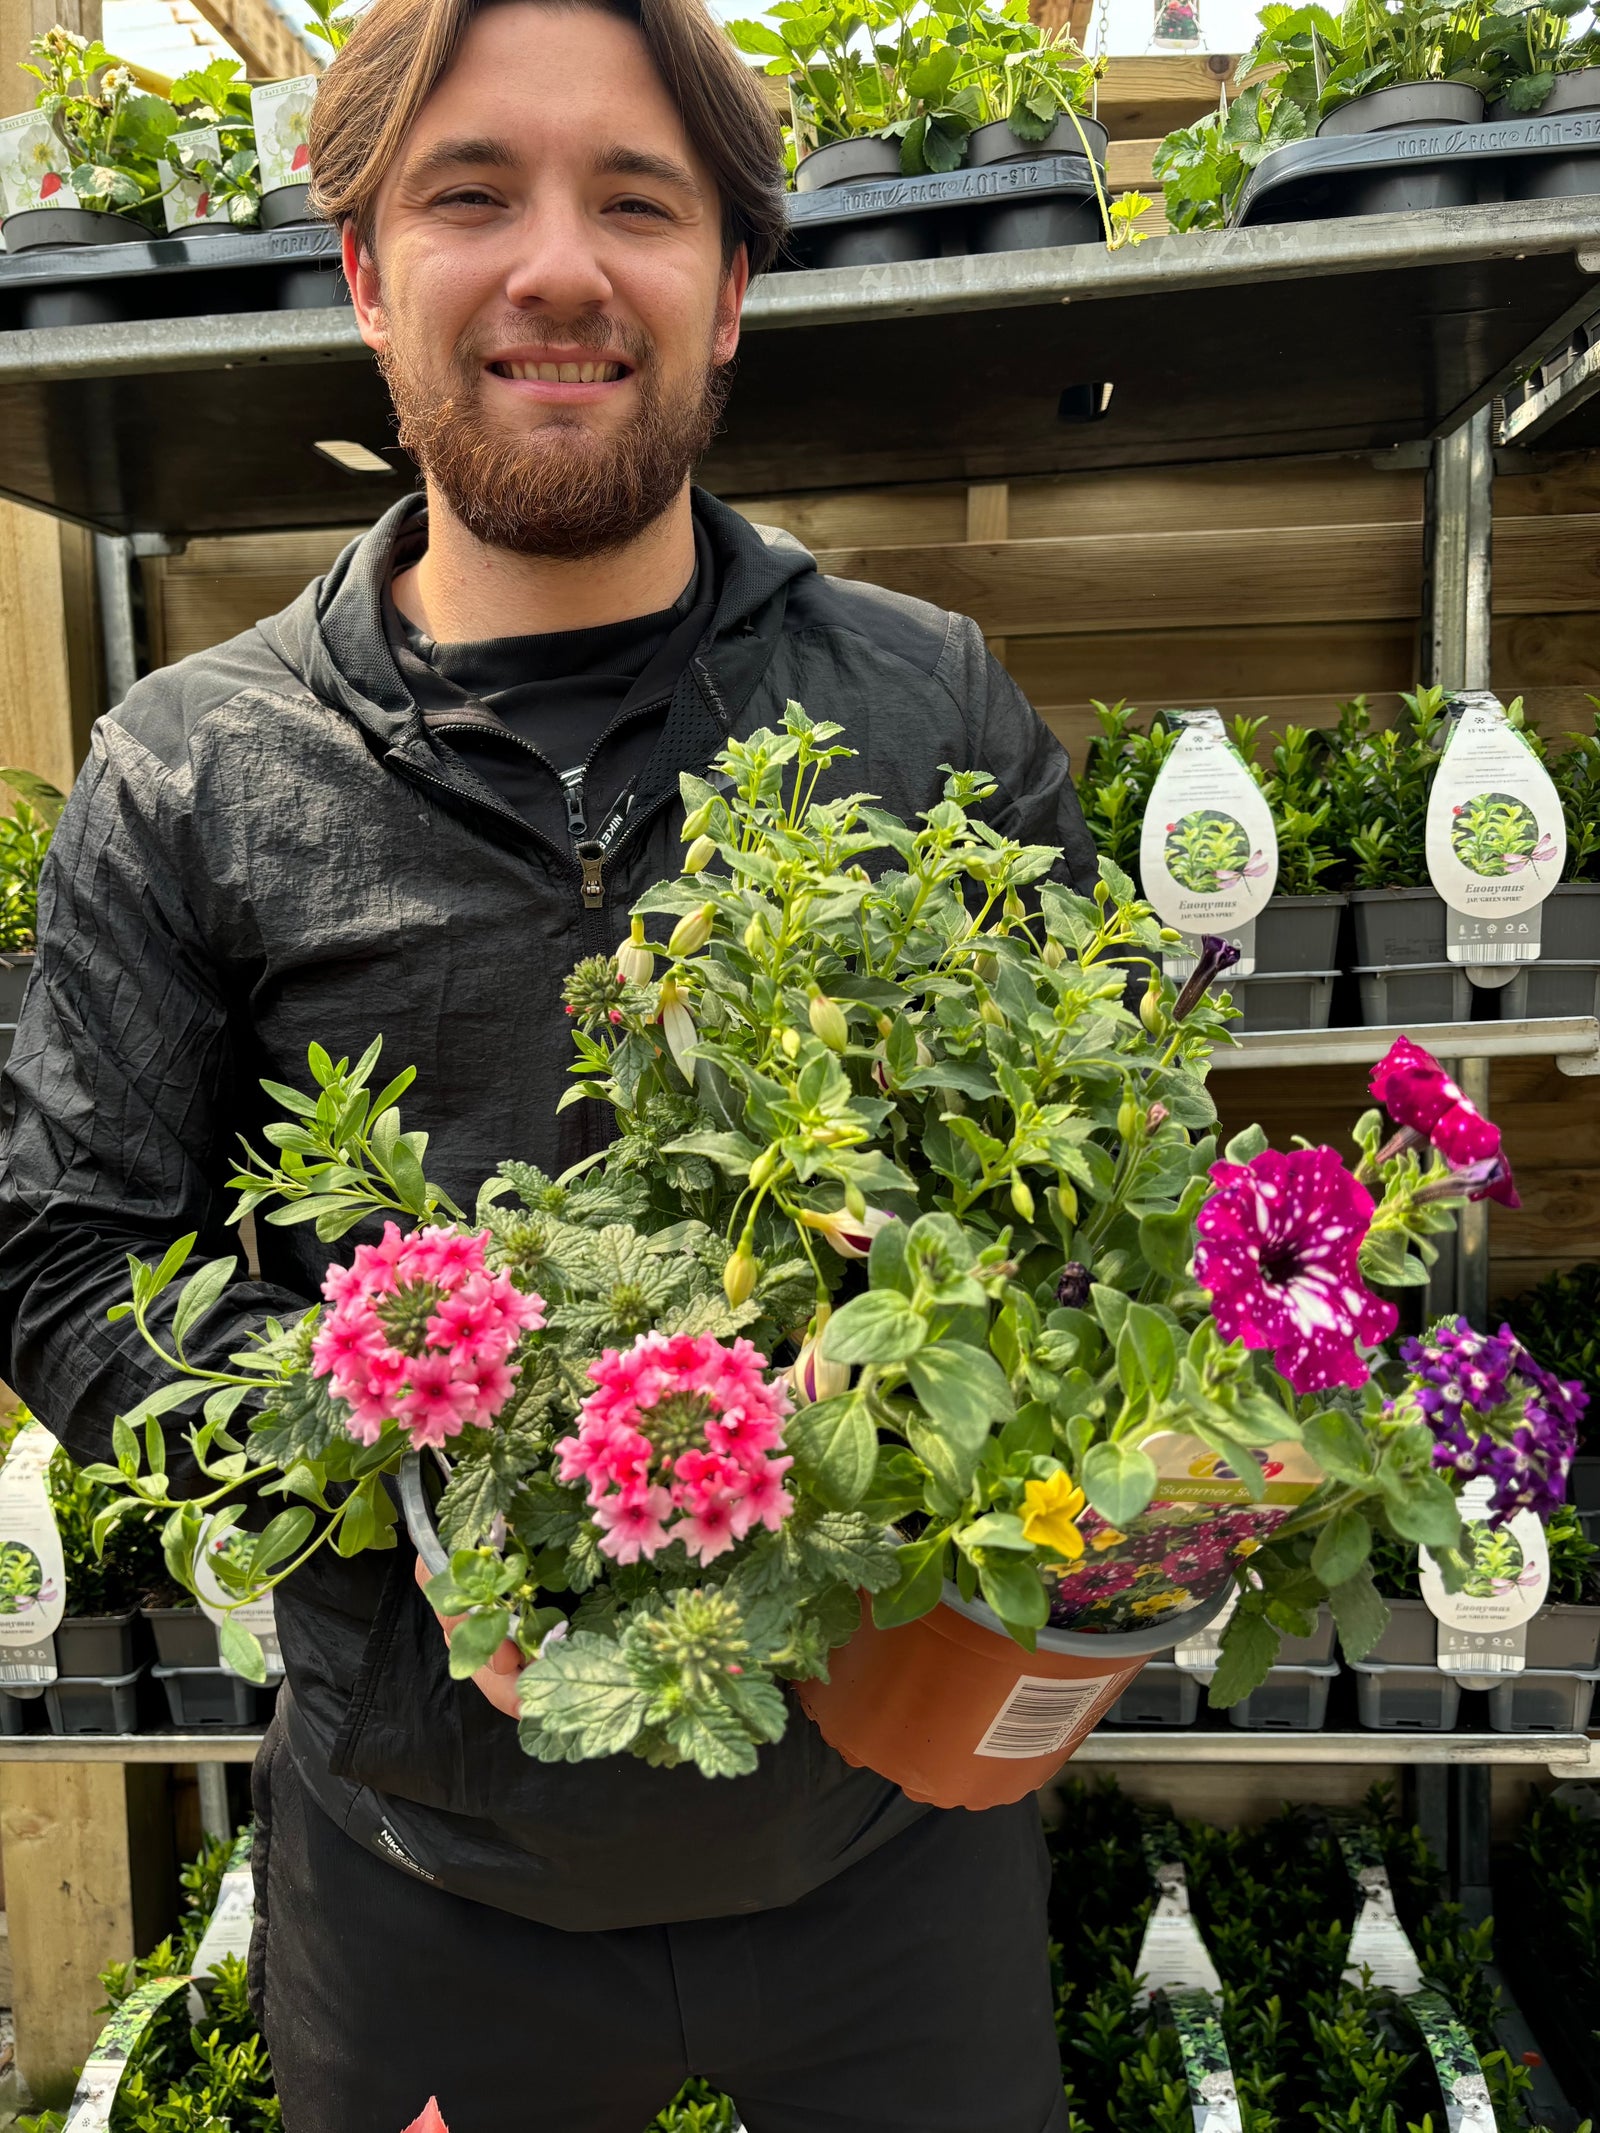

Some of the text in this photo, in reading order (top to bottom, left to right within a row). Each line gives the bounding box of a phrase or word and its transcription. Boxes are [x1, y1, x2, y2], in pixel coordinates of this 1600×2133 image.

[1397, 137, 1441, 158] NORM
[842, 190, 885, 212] NORM
[271, 236, 311, 255] NORM
[601, 814, 623, 845] NIKE
[1465, 883, 1525, 895] Euonymus
[1179, 900, 1237, 911] Euonymus
[380, 1829, 405, 1857] NIKE
